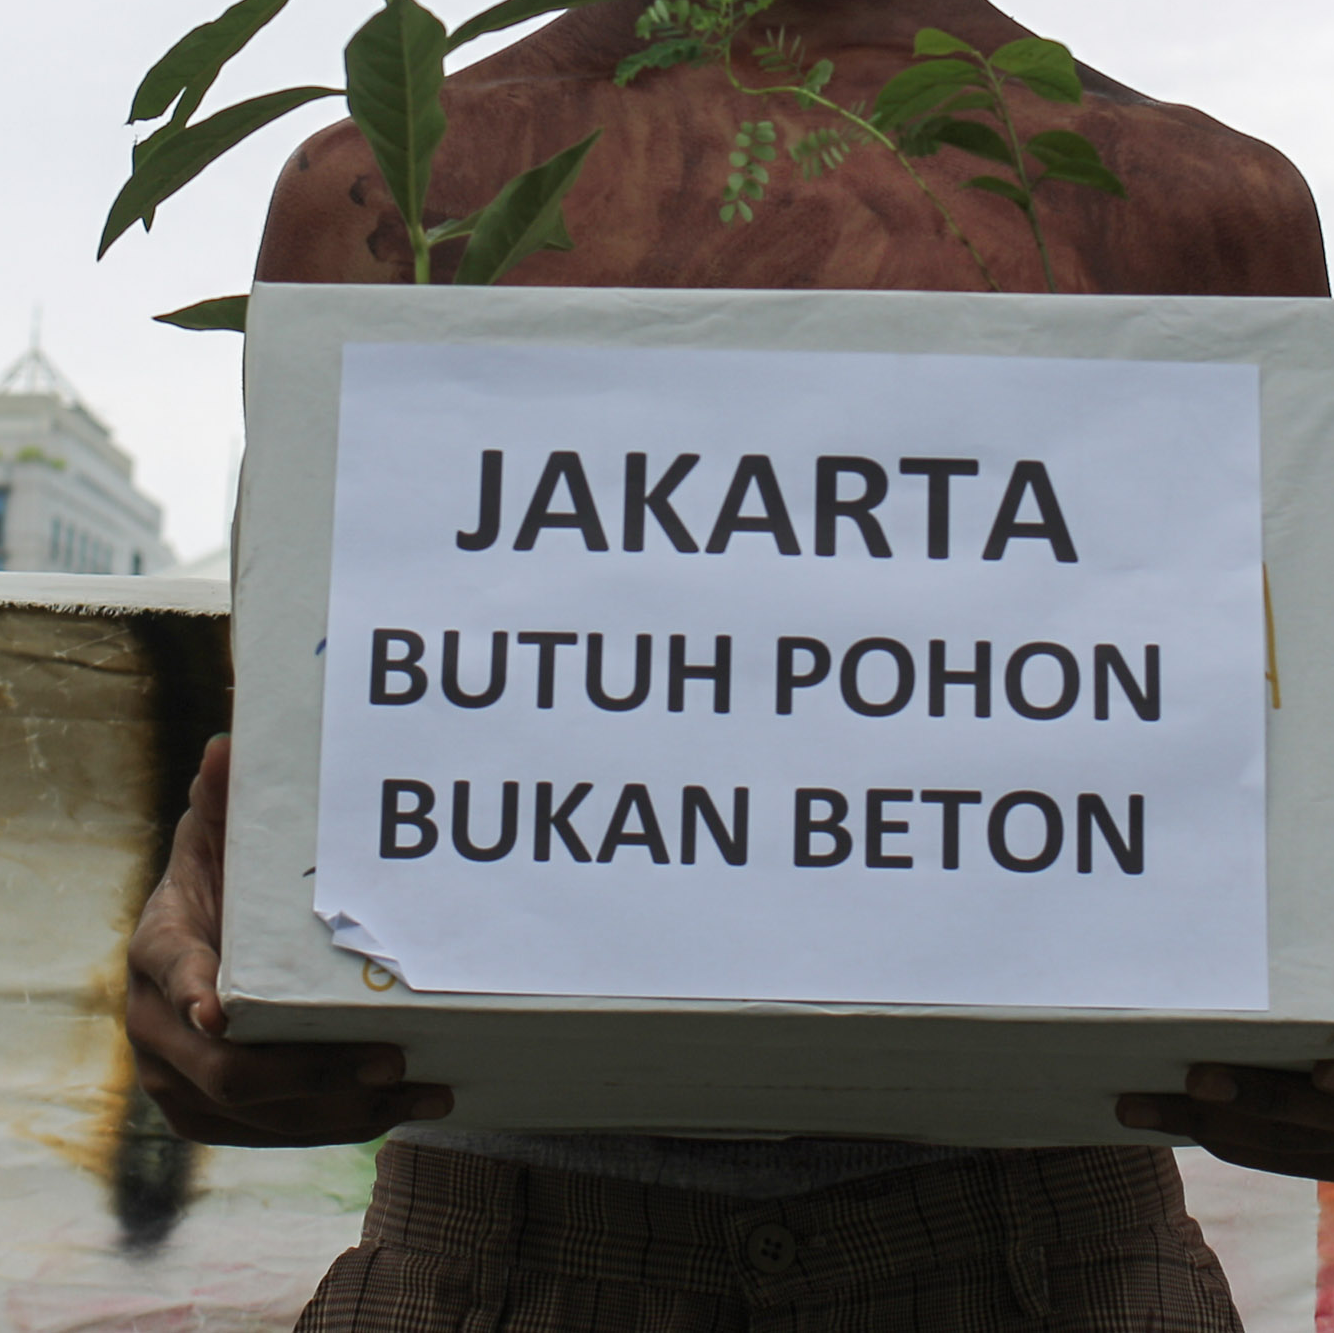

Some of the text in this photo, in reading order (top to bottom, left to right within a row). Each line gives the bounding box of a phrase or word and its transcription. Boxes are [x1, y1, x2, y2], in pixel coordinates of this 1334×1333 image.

[456, 450, 1078, 563] JAKARTA
[370, 629, 1160, 721] BUTUH POHON
[380, 779, 1144, 875] BUKAN BETON
